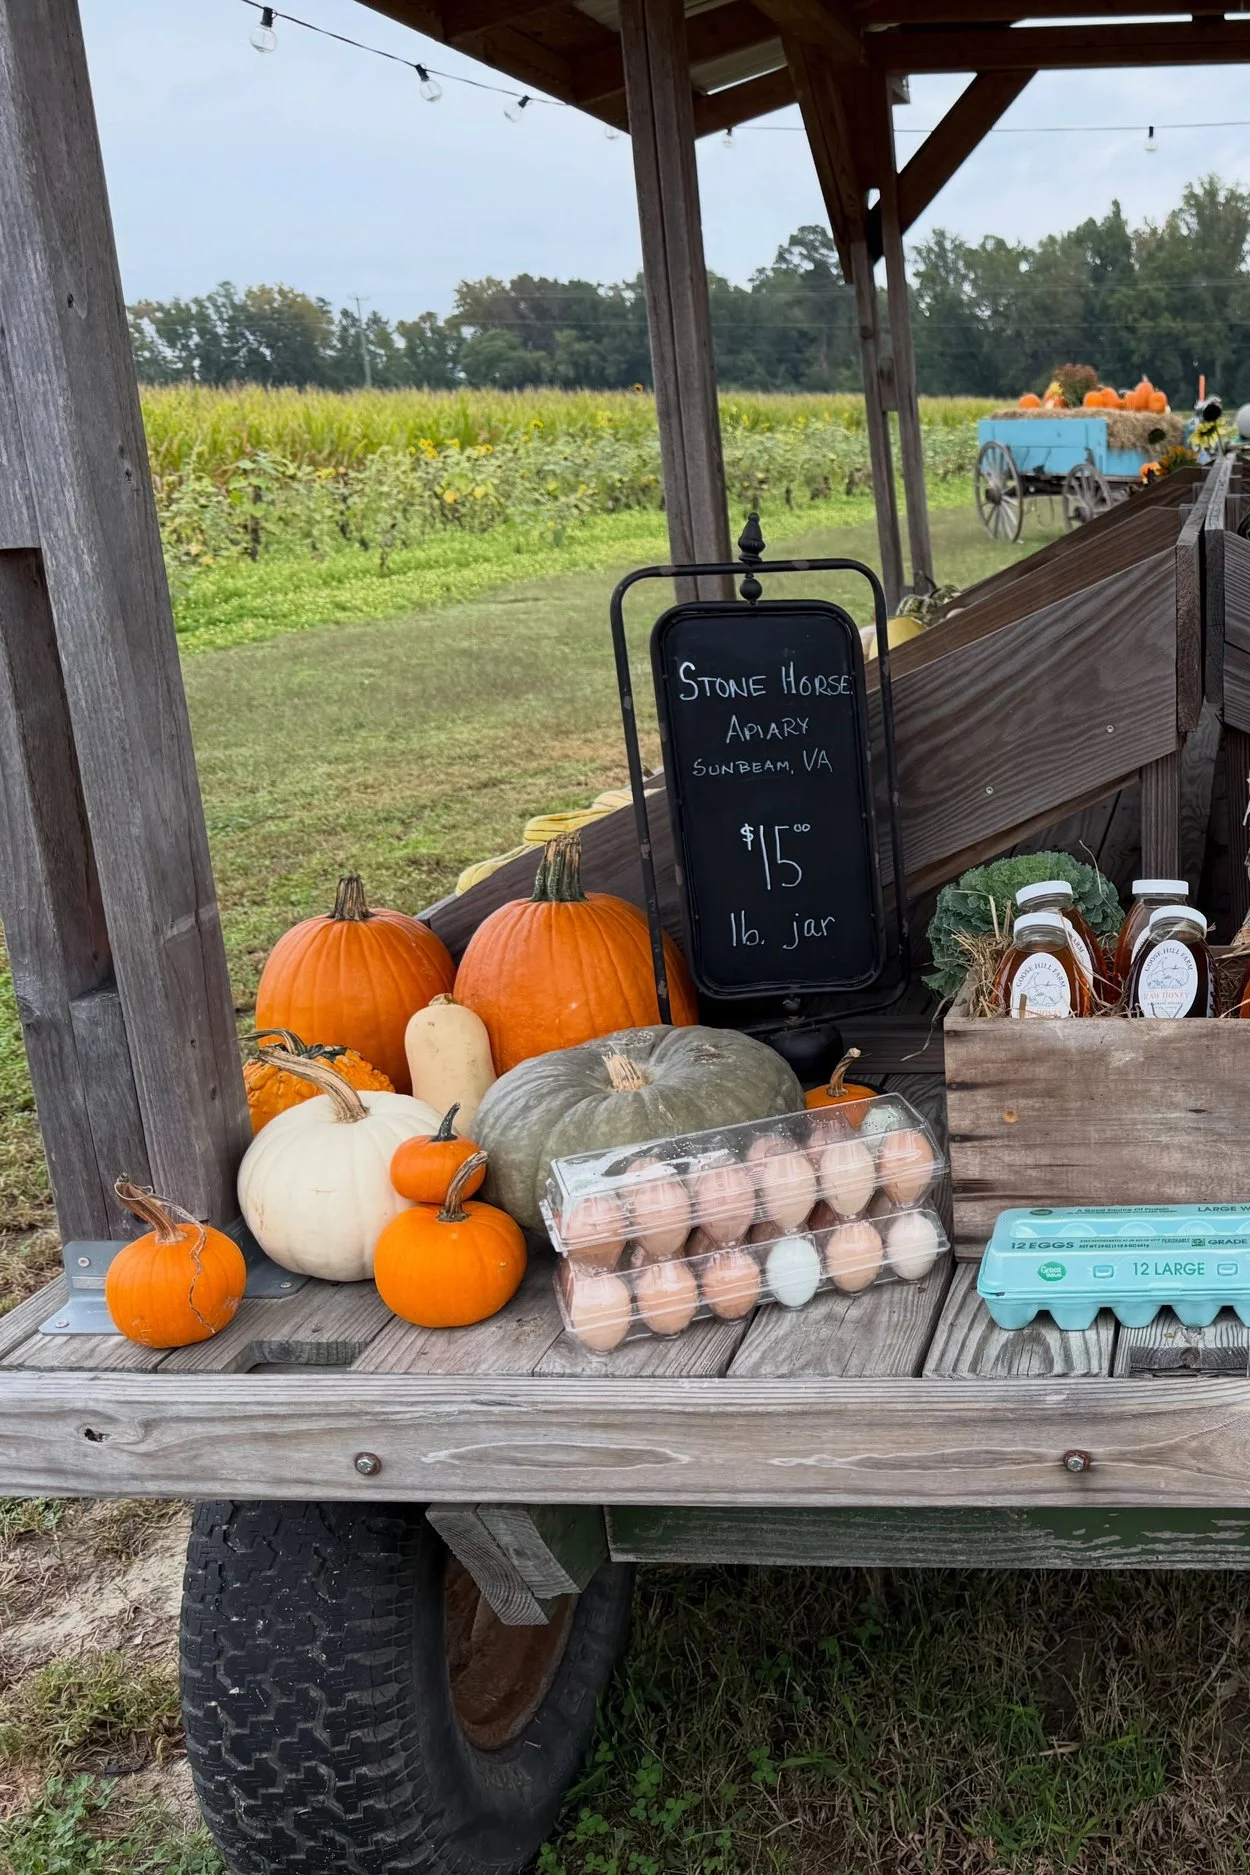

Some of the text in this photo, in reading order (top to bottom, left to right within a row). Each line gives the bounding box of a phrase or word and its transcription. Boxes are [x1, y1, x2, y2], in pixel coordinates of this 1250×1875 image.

[679, 661, 852, 700] STONE HORSE
[726, 715, 809, 743] APIARY
[692, 748, 833, 776] SUNBEAM, VA
[782, 913, 835, 950] jar
[1071, 938, 1084, 953] ARM
[1145, 947, 1194, 972] GOOSE HILL FARM
[1016, 962, 1066, 987] GOOSE HILL FARM
[1197, 1205, 1237, 1213] LARGE
[1010, 1242, 1026, 1250] 12
[1029, 1241, 1074, 1250] EGGS
[1208, 1238, 1248, 1246] GRADE
[1132, 1262, 1205, 1276] 12 LARGE
